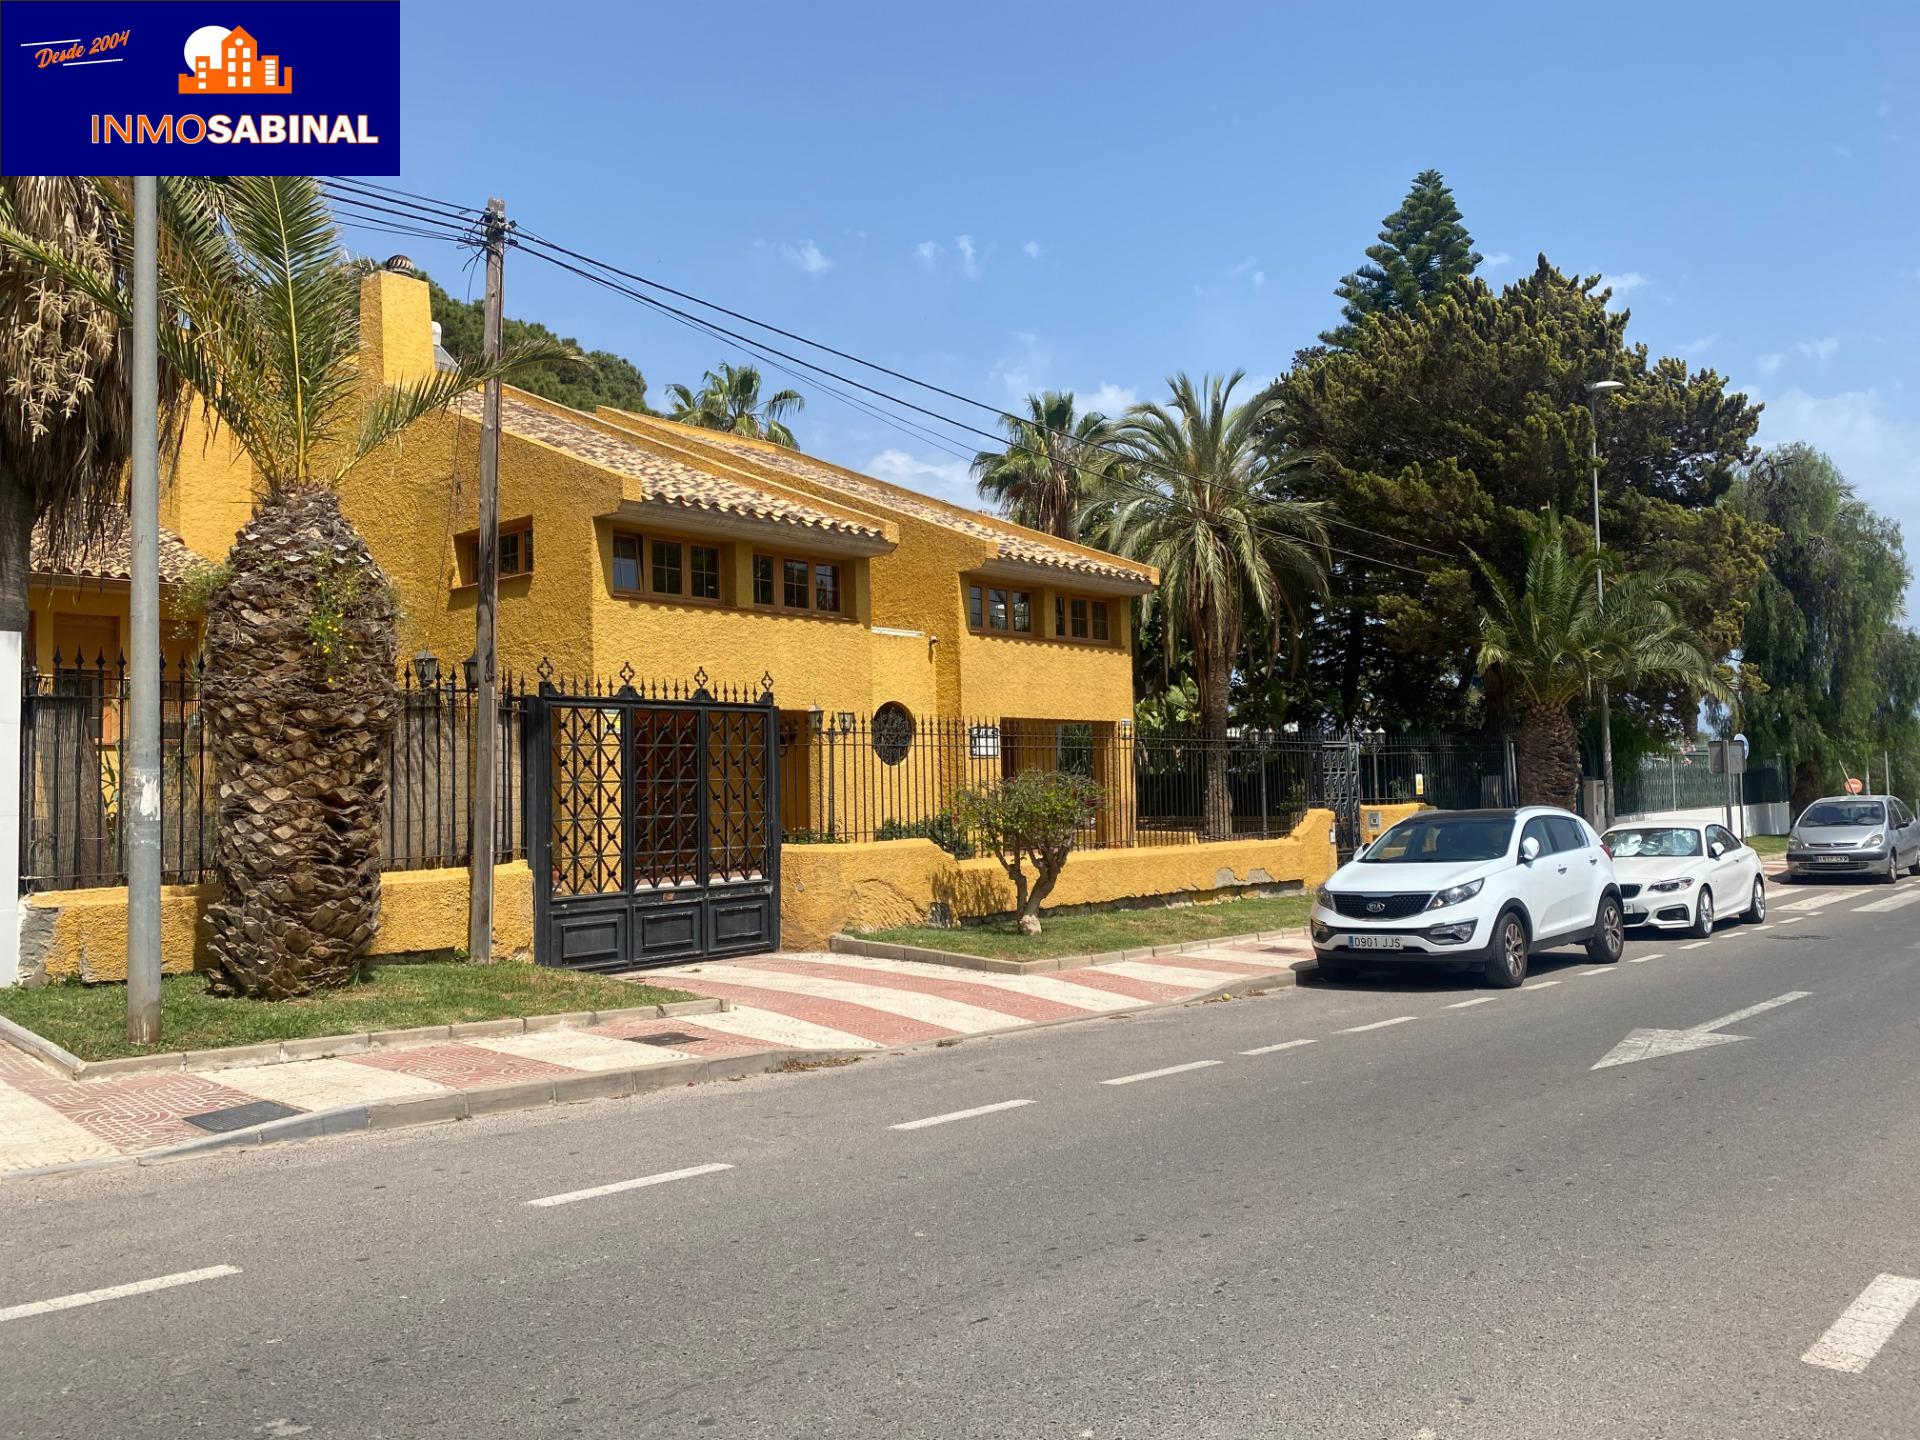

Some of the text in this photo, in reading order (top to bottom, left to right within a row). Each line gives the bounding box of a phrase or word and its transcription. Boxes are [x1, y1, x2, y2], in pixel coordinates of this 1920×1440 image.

[1367, 902, 1385, 912] KIA
[1354, 937, 1401, 948] 0901 JJS
